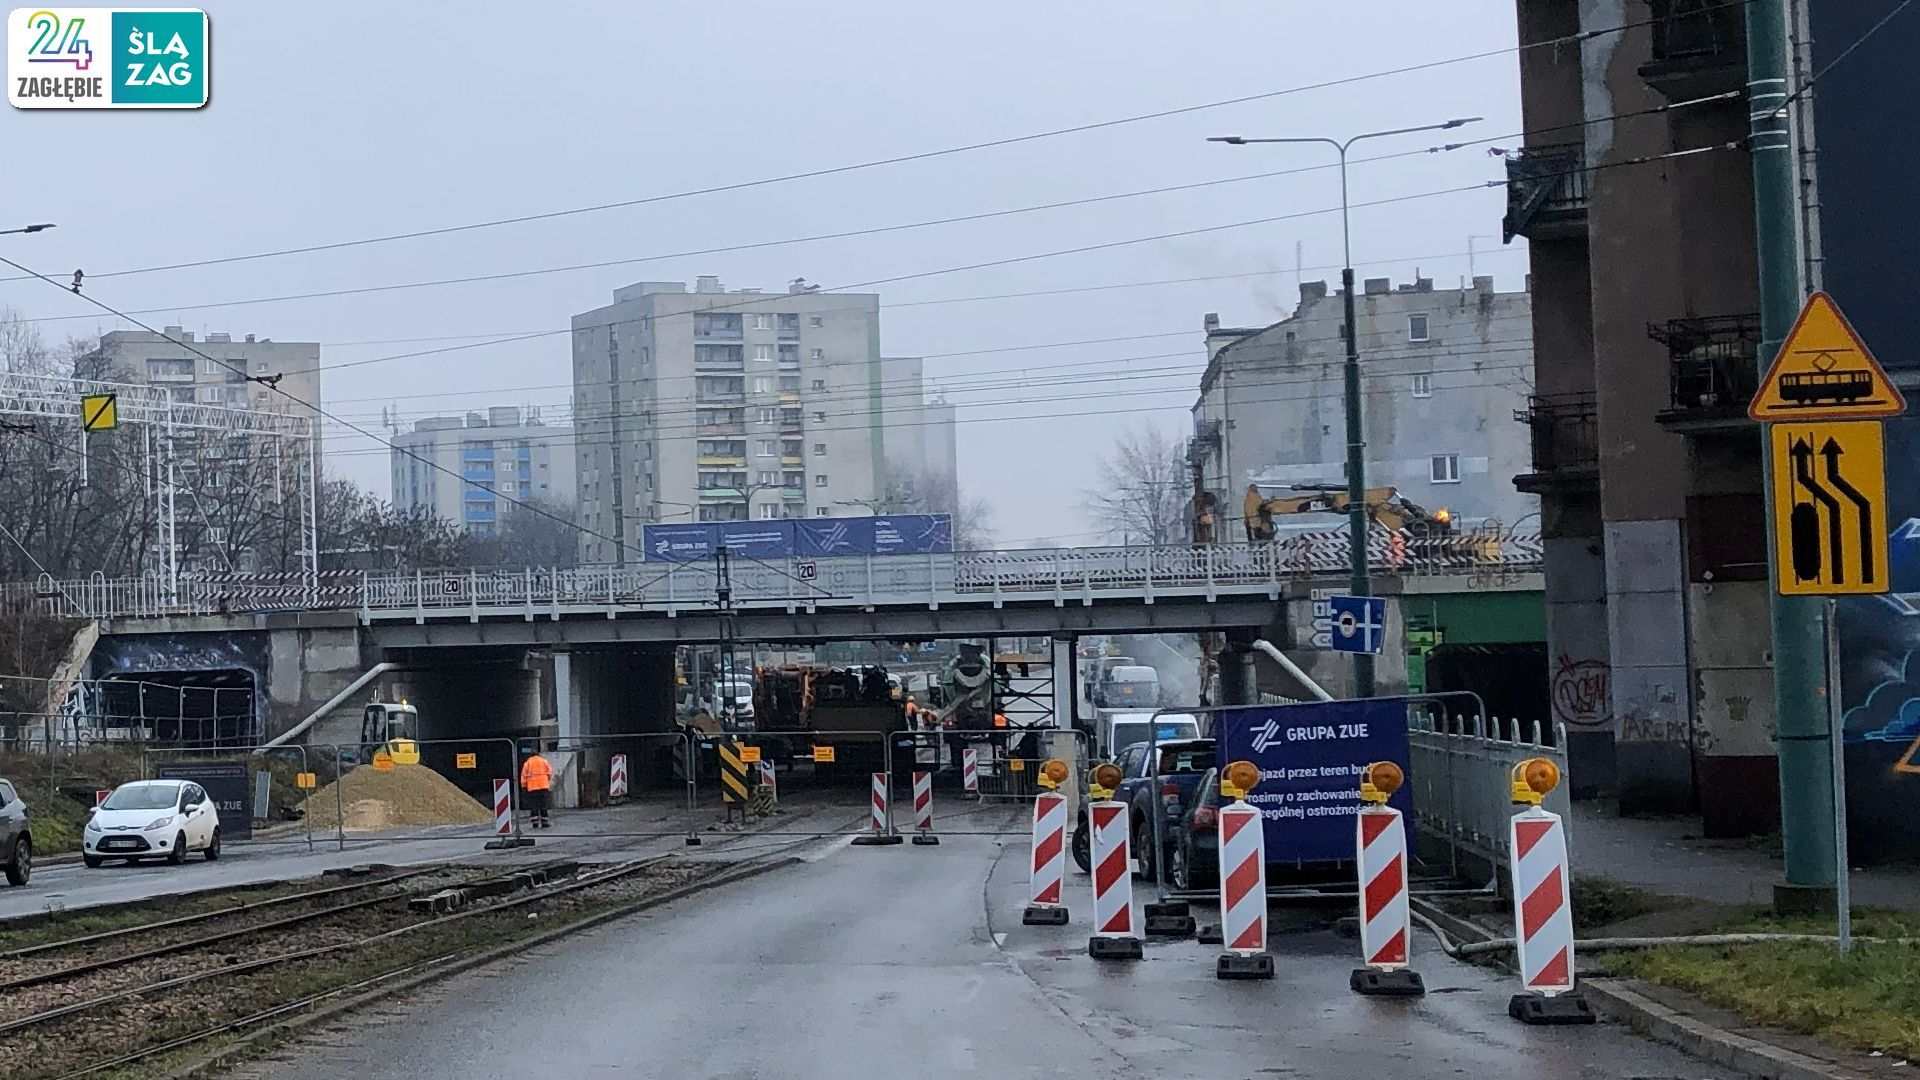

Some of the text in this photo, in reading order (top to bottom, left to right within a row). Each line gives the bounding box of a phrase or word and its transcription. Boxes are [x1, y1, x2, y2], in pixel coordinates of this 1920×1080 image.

[800, 565, 814, 579] 20
[445, 580, 458, 592] 20
[1286, 723, 1369, 742] GRUPA ZUE
[1257, 766, 1286, 782] ejazd
[1287, 767, 1318, 781] przez
[1320, 766, 1350, 778] teren
[1247, 791, 1284, 805] rosimy
[1286, 793, 1294, 802] o
[223, 800, 242, 811] ZUE
